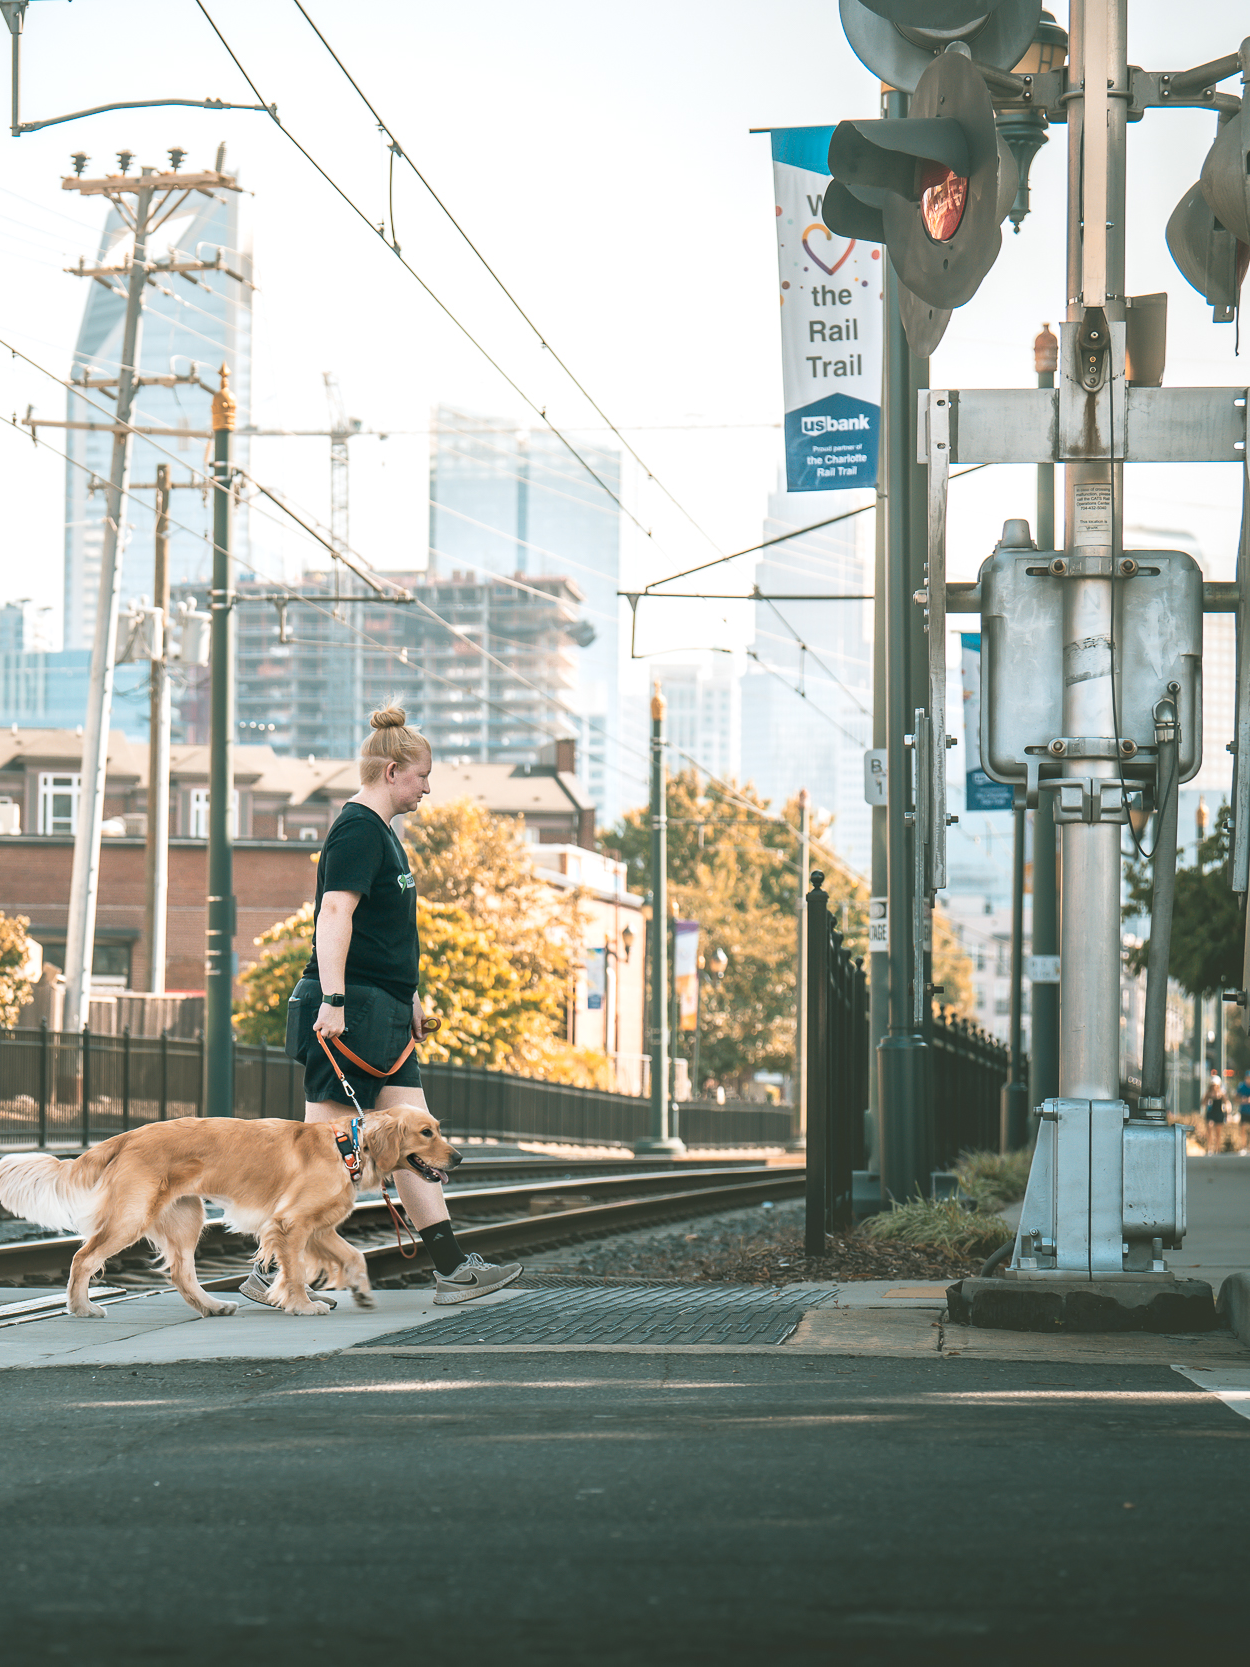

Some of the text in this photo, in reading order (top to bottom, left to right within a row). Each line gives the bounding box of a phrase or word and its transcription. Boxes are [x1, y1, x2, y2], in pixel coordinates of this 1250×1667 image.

[806, 194, 824, 217] W
[811, 285, 853, 306] the
[809, 318, 859, 342] Rail
[806, 354, 863, 378] Trail
[801, 414, 870, 435] usbank
[807, 453, 867, 465] the Charlotte
[833, 445, 855, 453] partner
[817, 466, 857, 477] Rail Trail
[870, 924, 887, 941] TAGE
